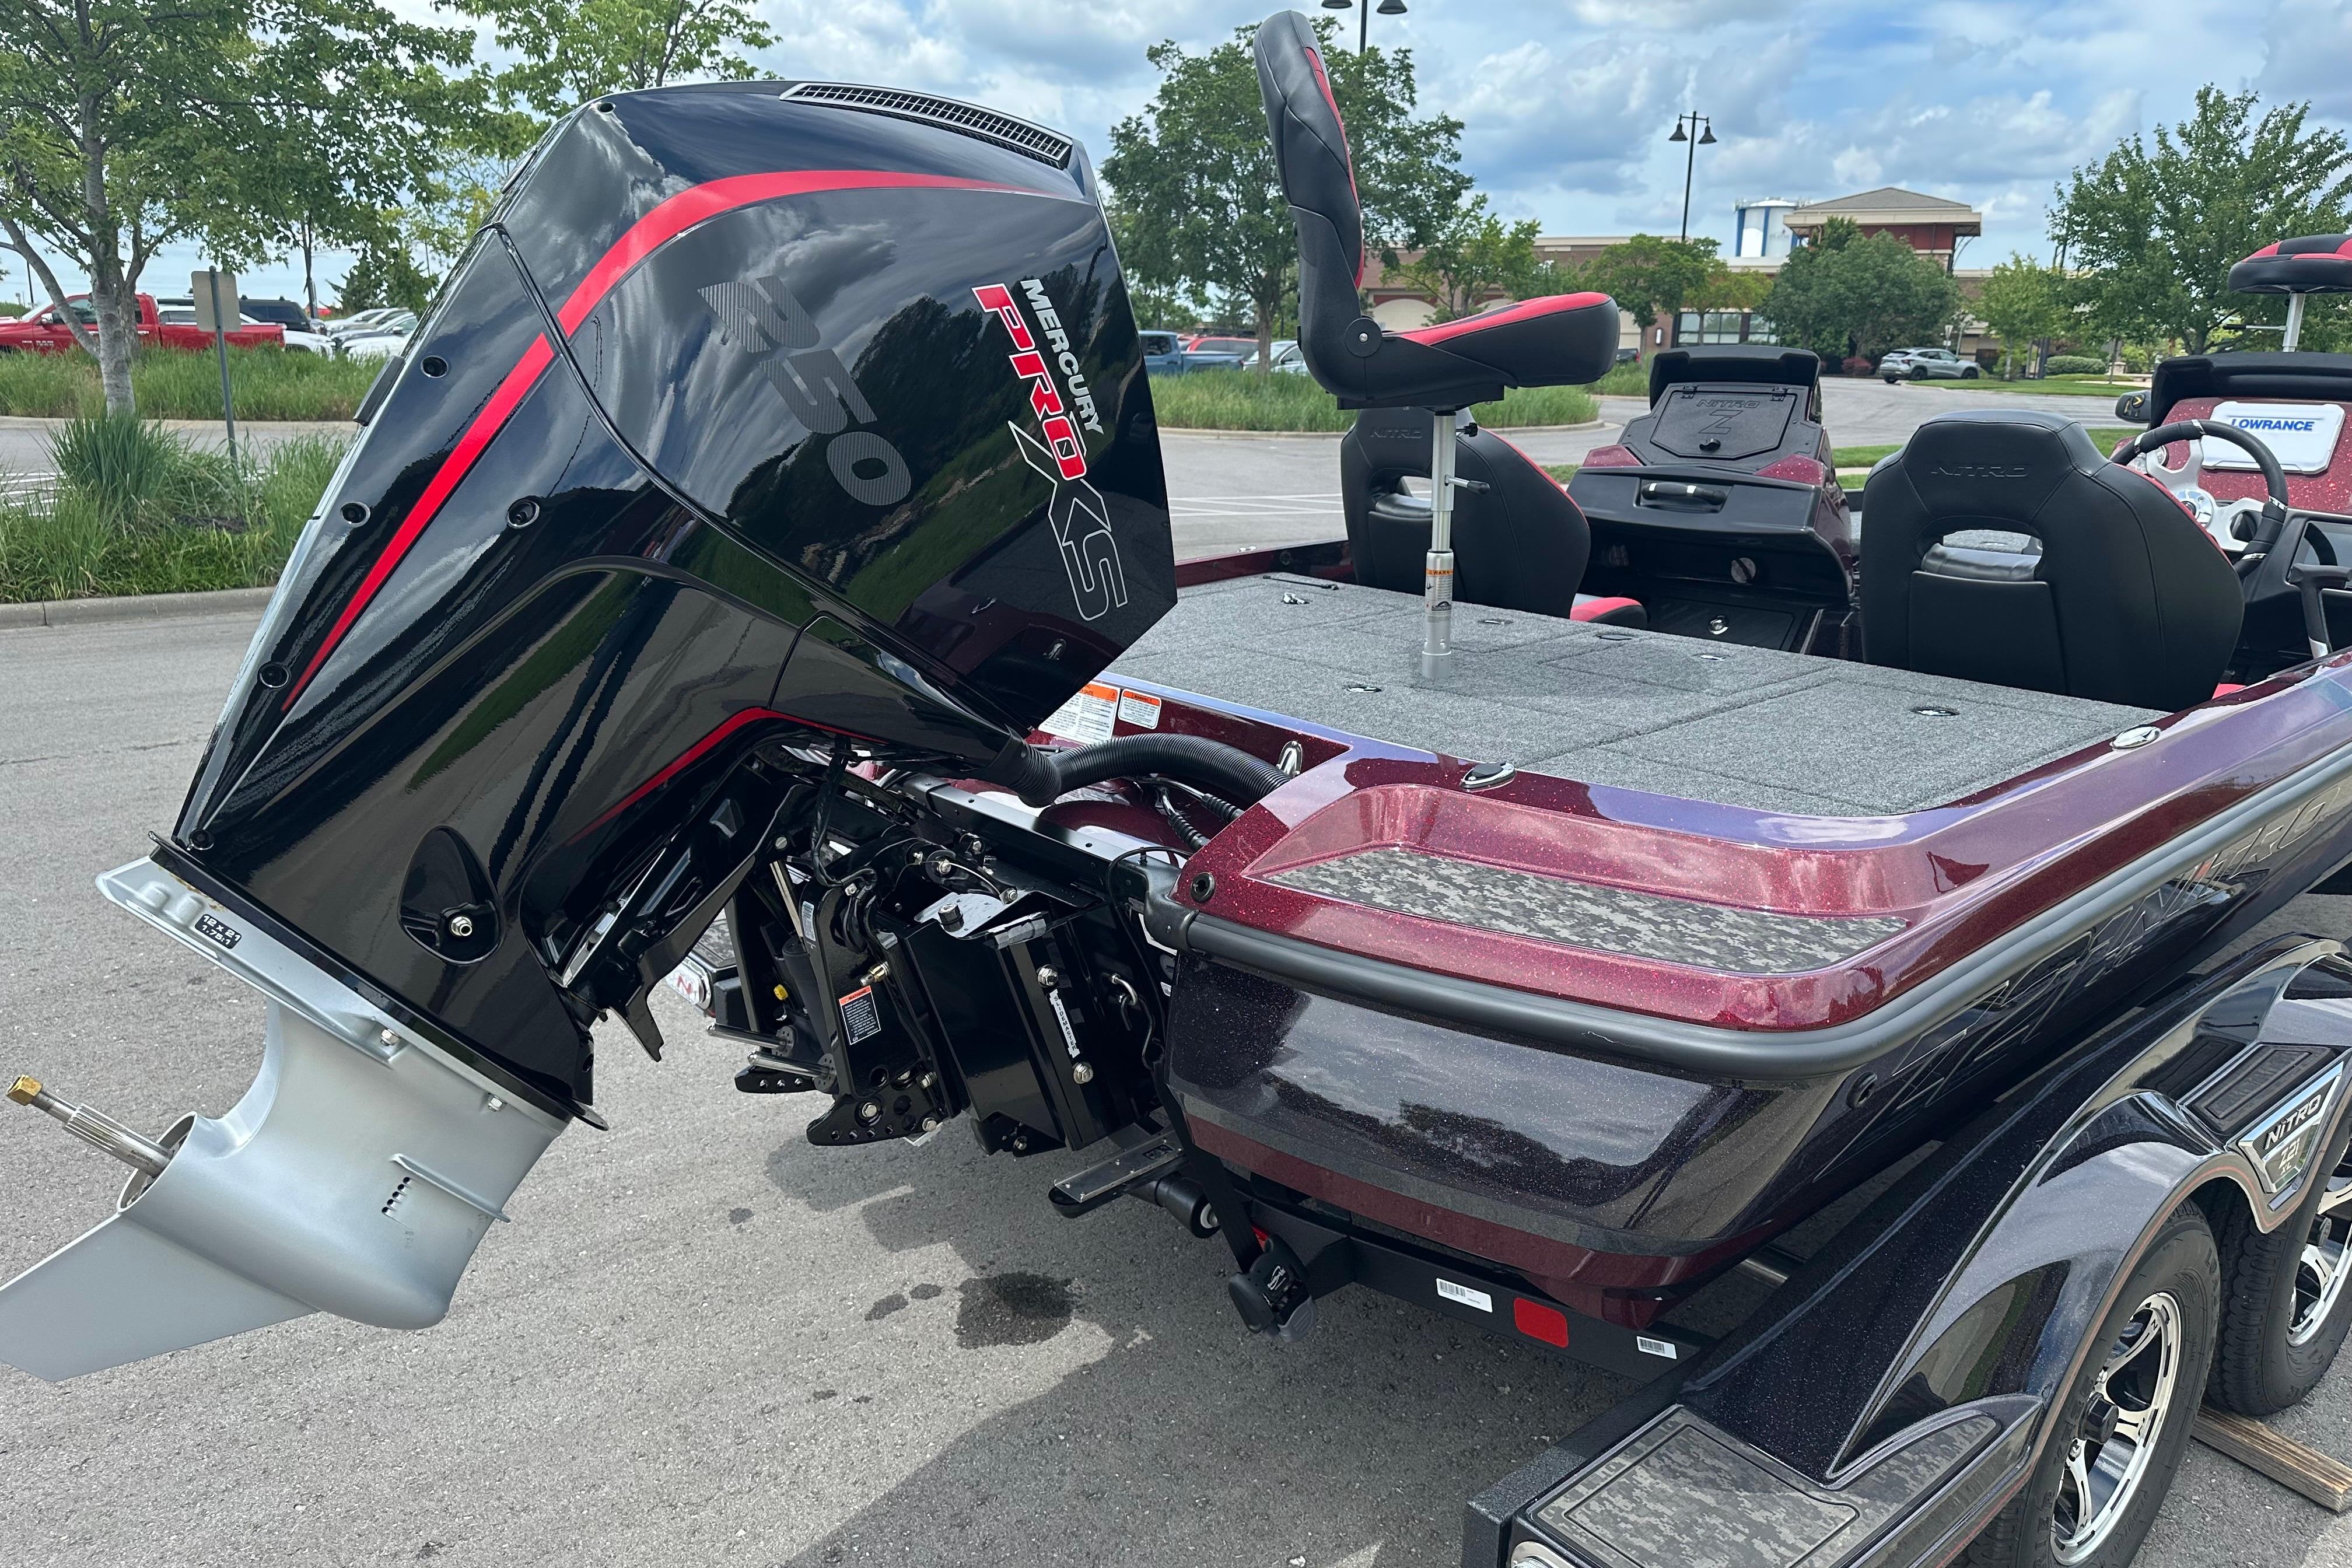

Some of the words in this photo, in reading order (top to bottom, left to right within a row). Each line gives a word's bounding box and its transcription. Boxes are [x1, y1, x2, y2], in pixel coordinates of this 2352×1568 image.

[1020, 279, 1104, 435] MERCURY
[698, 275, 912, 506] 250
[971, 283, 1087, 481] PRO
[1696, 399, 1761, 408] NITRO
[1370, 427, 1423, 439] NITRO
[1698, 409, 1744, 435] Z
[2231, 418, 2315, 432] LOWRANCE
[1930, 464, 2030, 477] NITRO
[1007, 410, 1128, 621] XS
[202, 925, 231, 945] 1.75:1
[204, 915, 218, 927] 12
[225, 929, 242, 942] 21
[1054, 996, 1077, 1051] SLIDEMASTER
[2264, 1094, 2322, 1150] NITRO
[2280, 1162, 2292, 1176] XL
